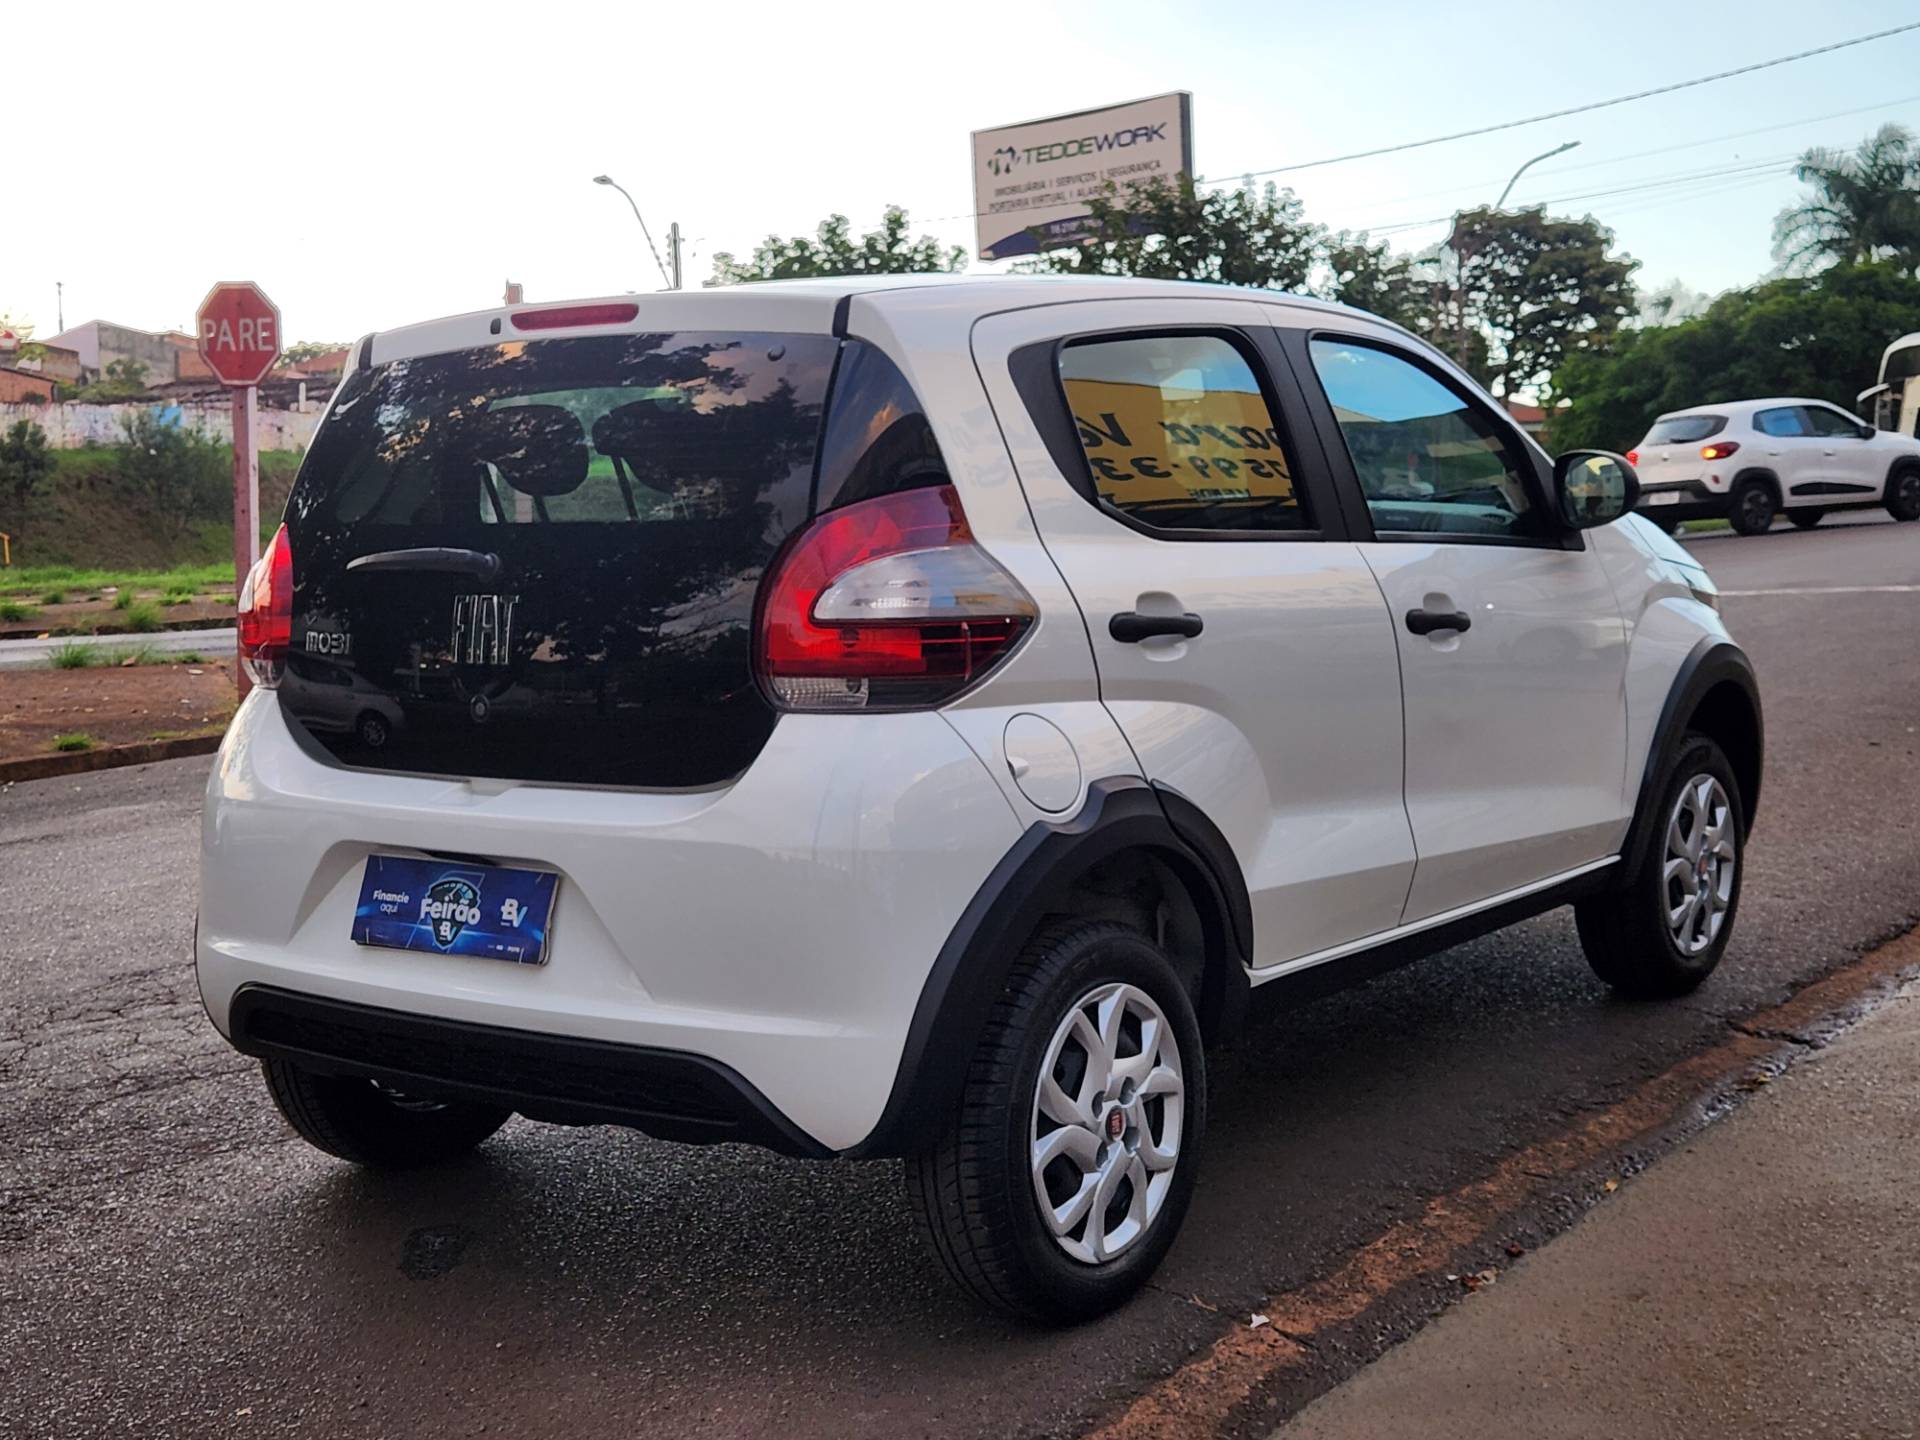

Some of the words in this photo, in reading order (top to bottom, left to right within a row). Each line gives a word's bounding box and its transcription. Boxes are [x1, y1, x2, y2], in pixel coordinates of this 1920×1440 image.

[1022, 122, 1167, 164] TEDDEWORK
[202, 317, 274, 352] PARE
[305, 631, 350, 655] MOBI
[452, 594, 520, 665] FIAT
[373, 889, 410, 904] Financie
[380, 902, 399, 914] aqui
[420, 896, 481, 925] Feirão
